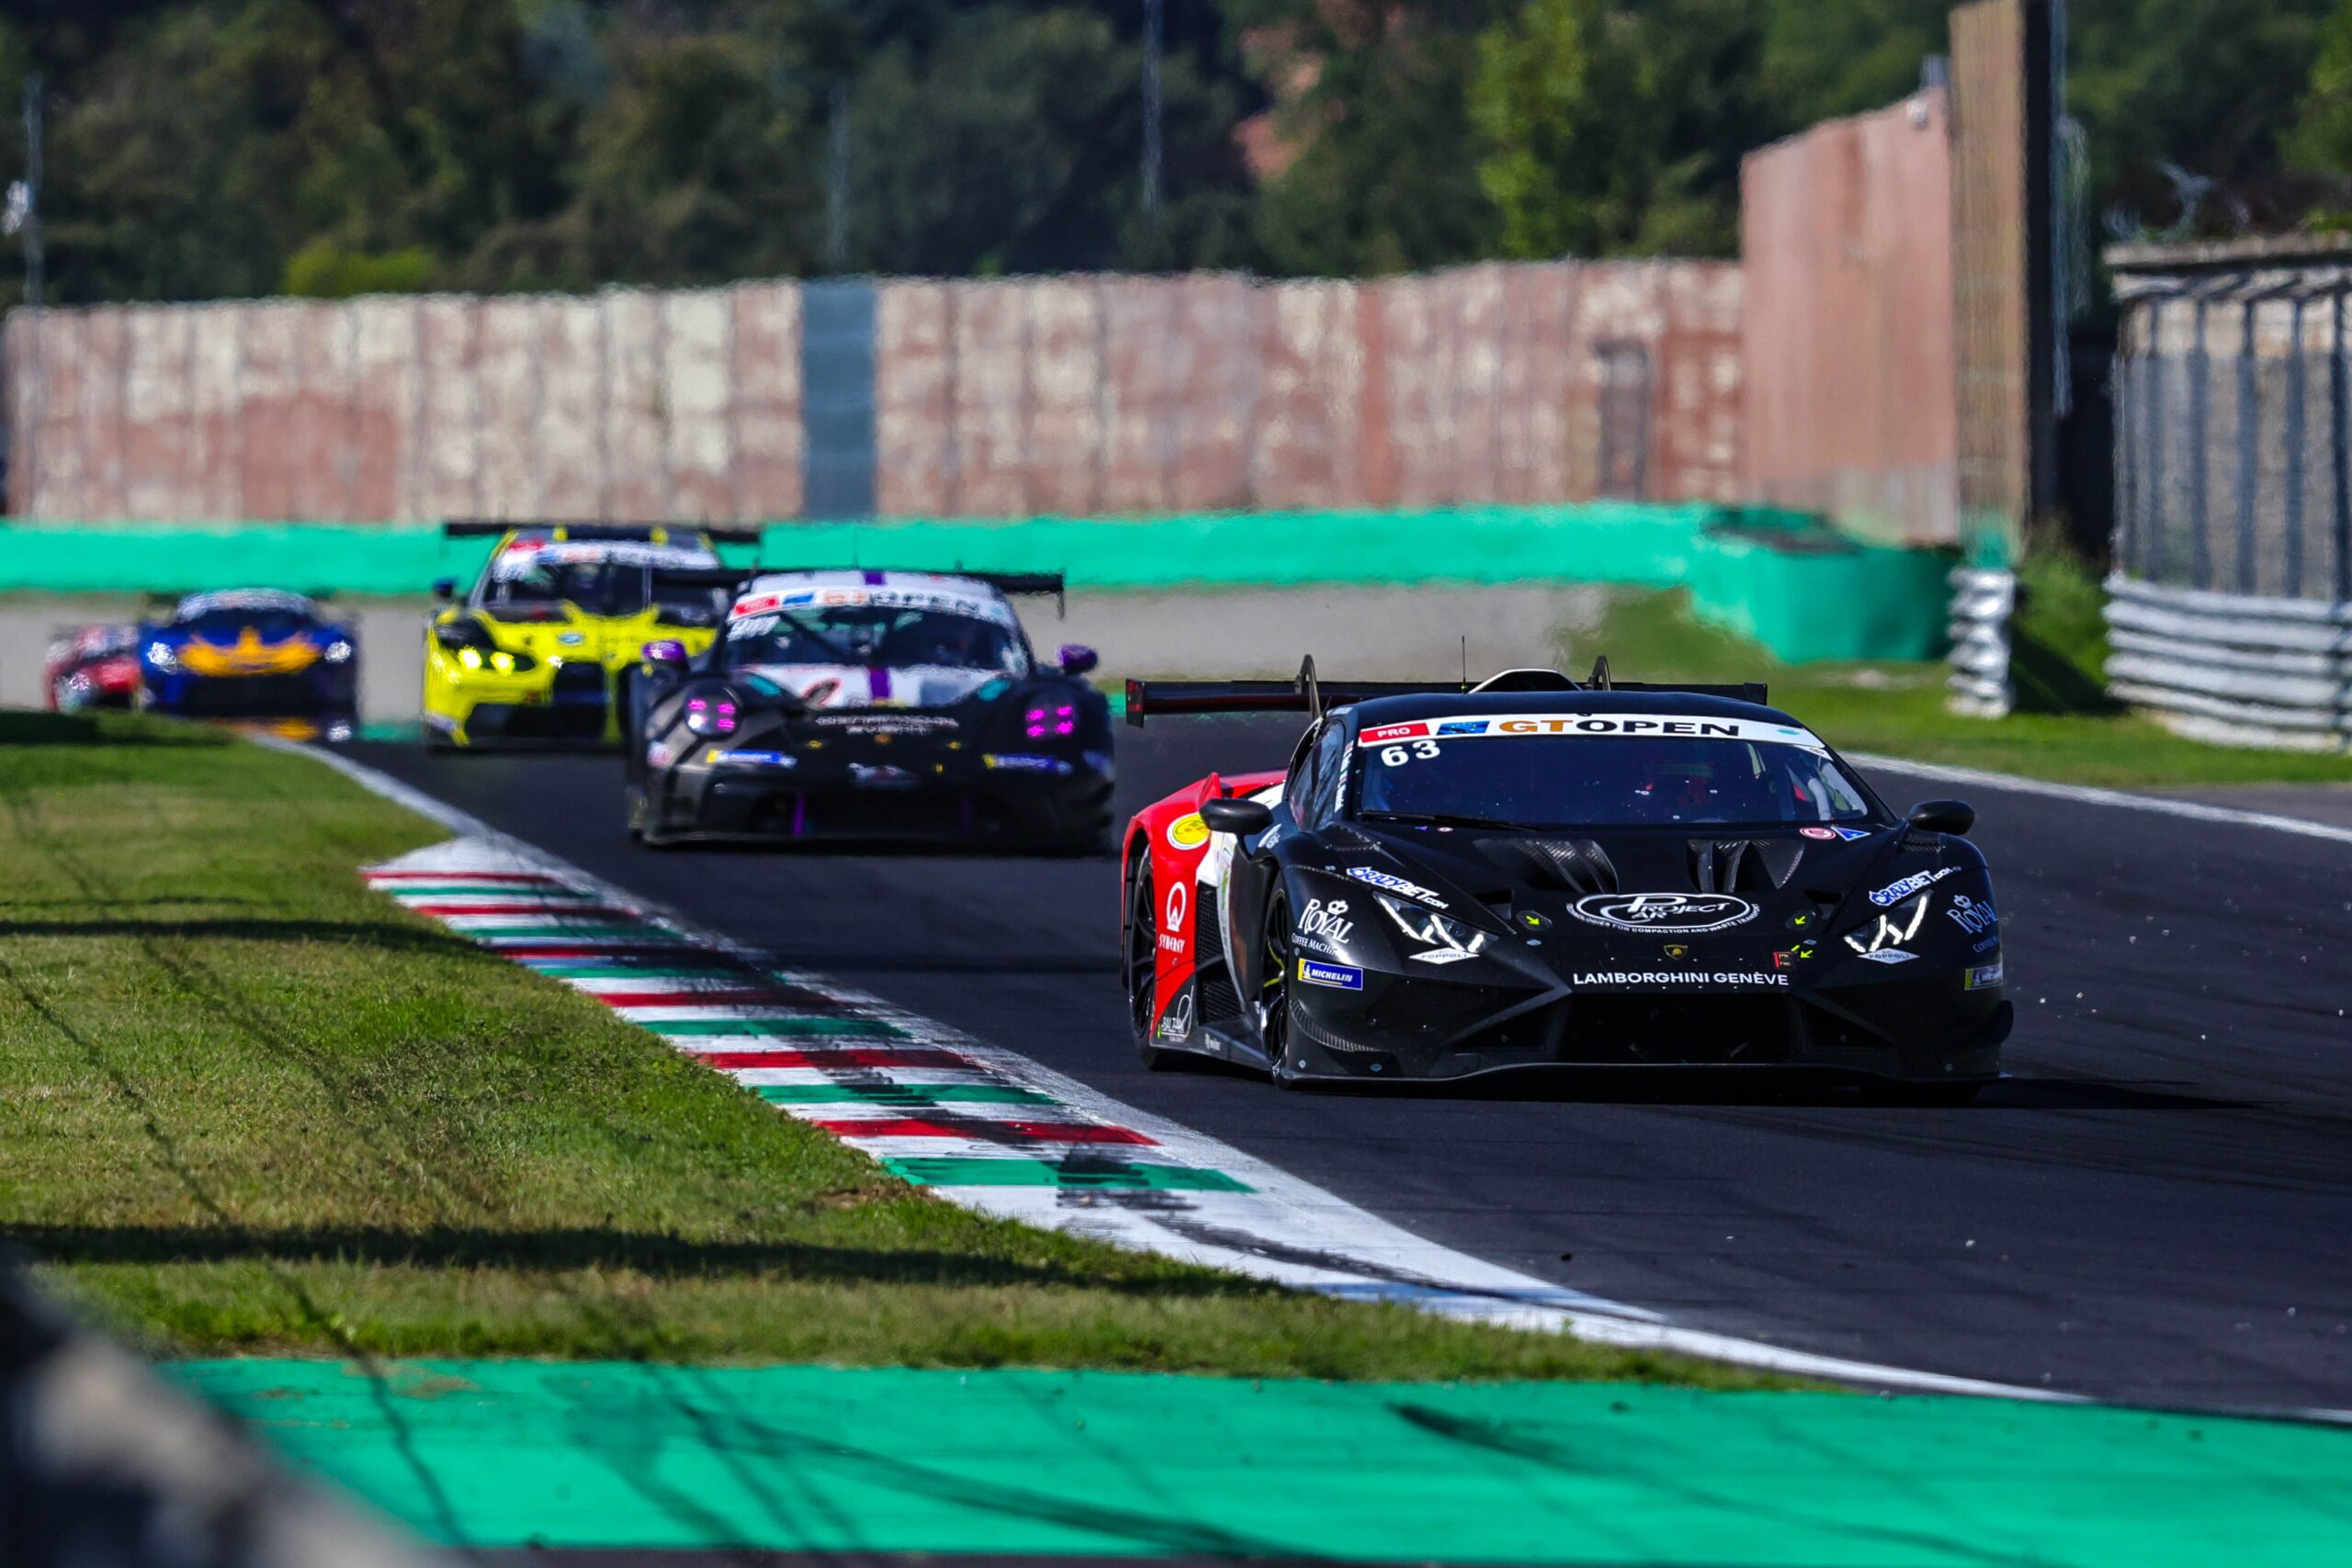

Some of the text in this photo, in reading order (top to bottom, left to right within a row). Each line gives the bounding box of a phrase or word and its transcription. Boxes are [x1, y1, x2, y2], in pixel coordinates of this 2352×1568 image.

[1377, 726, 1411, 738] PRO
[1380, 739, 1441, 767] 63
[1297, 898, 1354, 944] ROYAL
[1611, 922, 1630, 932] FOR
[1709, 921, 1736, 932] WASTE
[1159, 933, 1186, 954] SYNERGY
[1291, 932, 1309, 947] COFFEE
[1311, 969, 1353, 982] MICHELIN
[1573, 971, 1789, 986] LAMBORGHINI GENÈVE
